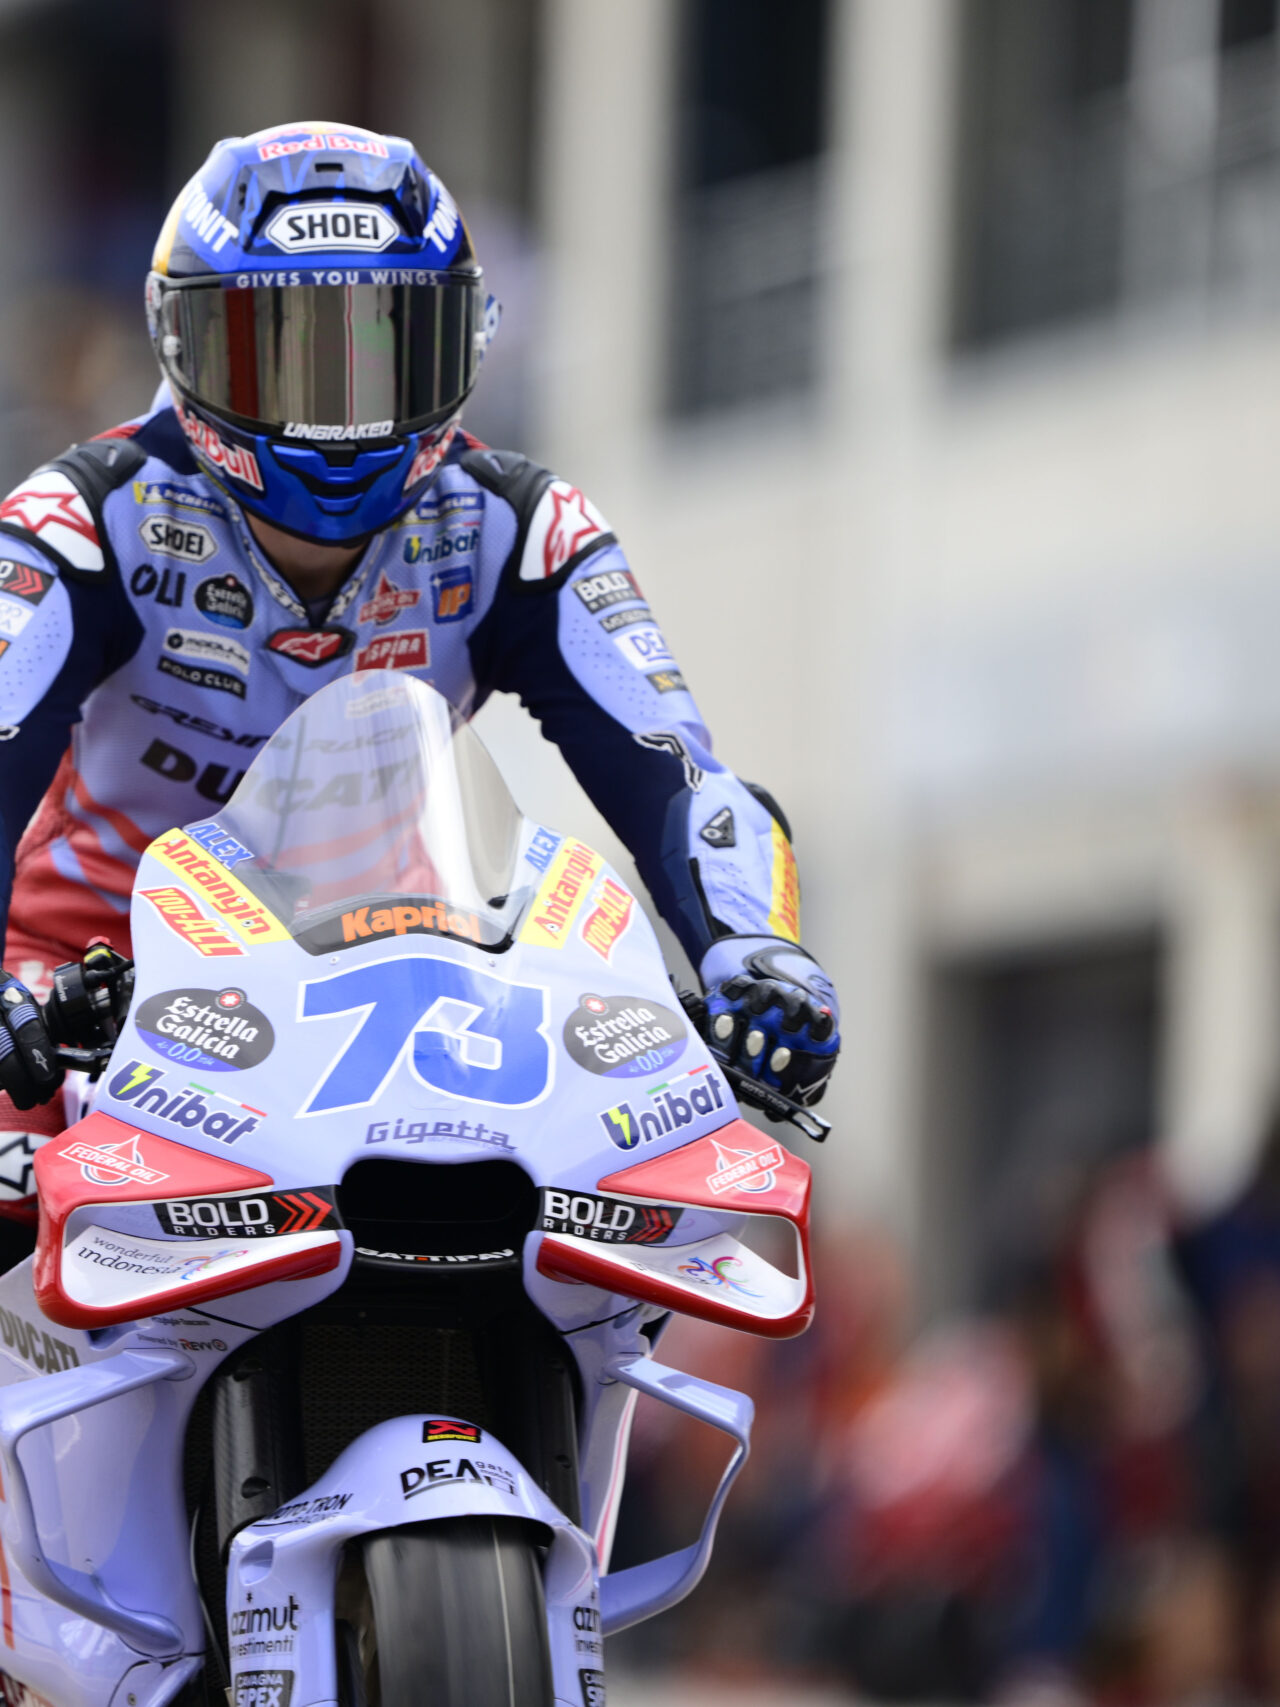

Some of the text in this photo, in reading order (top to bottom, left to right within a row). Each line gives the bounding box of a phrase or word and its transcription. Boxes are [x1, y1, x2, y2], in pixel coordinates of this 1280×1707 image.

[260, 134, 387, 160] Red Bull
[288, 213, 380, 242] SHOEI
[237, 270, 439, 289] GIVES YOU WINGS
[283, 420, 394, 441] UNBRAKED
[150, 523, 205, 557] SHOEI
[130, 563, 187, 608] OLI
[437, 583, 472, 617] IP
[188, 823, 253, 869] ALEX
[524, 827, 560, 873] ALEX
[154, 838, 271, 935] Antangin
[533, 843, 596, 941] Antangin
[341, 901, 481, 944] Kapriol
[156, 1013, 240, 1059] Galicia
[164, 996, 259, 1042] Estrella
[296, 954, 554, 1117] 73
[575, 1007, 657, 1047] Estrella
[594, 1026, 672, 1064] Galicia
[110, 1061, 260, 1145] Unibat
[602, 1073, 724, 1150] Unibat
[365, 1117, 517, 1150] Gigetta
[69, 1146, 157, 1183] FEDERAL OIL
[711, 1152, 778, 1188] FEDERAL OIL
[169, 1199, 269, 1227] BOLD
[175, 1223, 276, 1236] RIDERS
[543, 1217, 628, 1242] RIDERS
[544, 1190, 636, 1232] BOLD
[94, 1236, 174, 1264] wonderful
[231, 1594, 299, 1637] azimut
